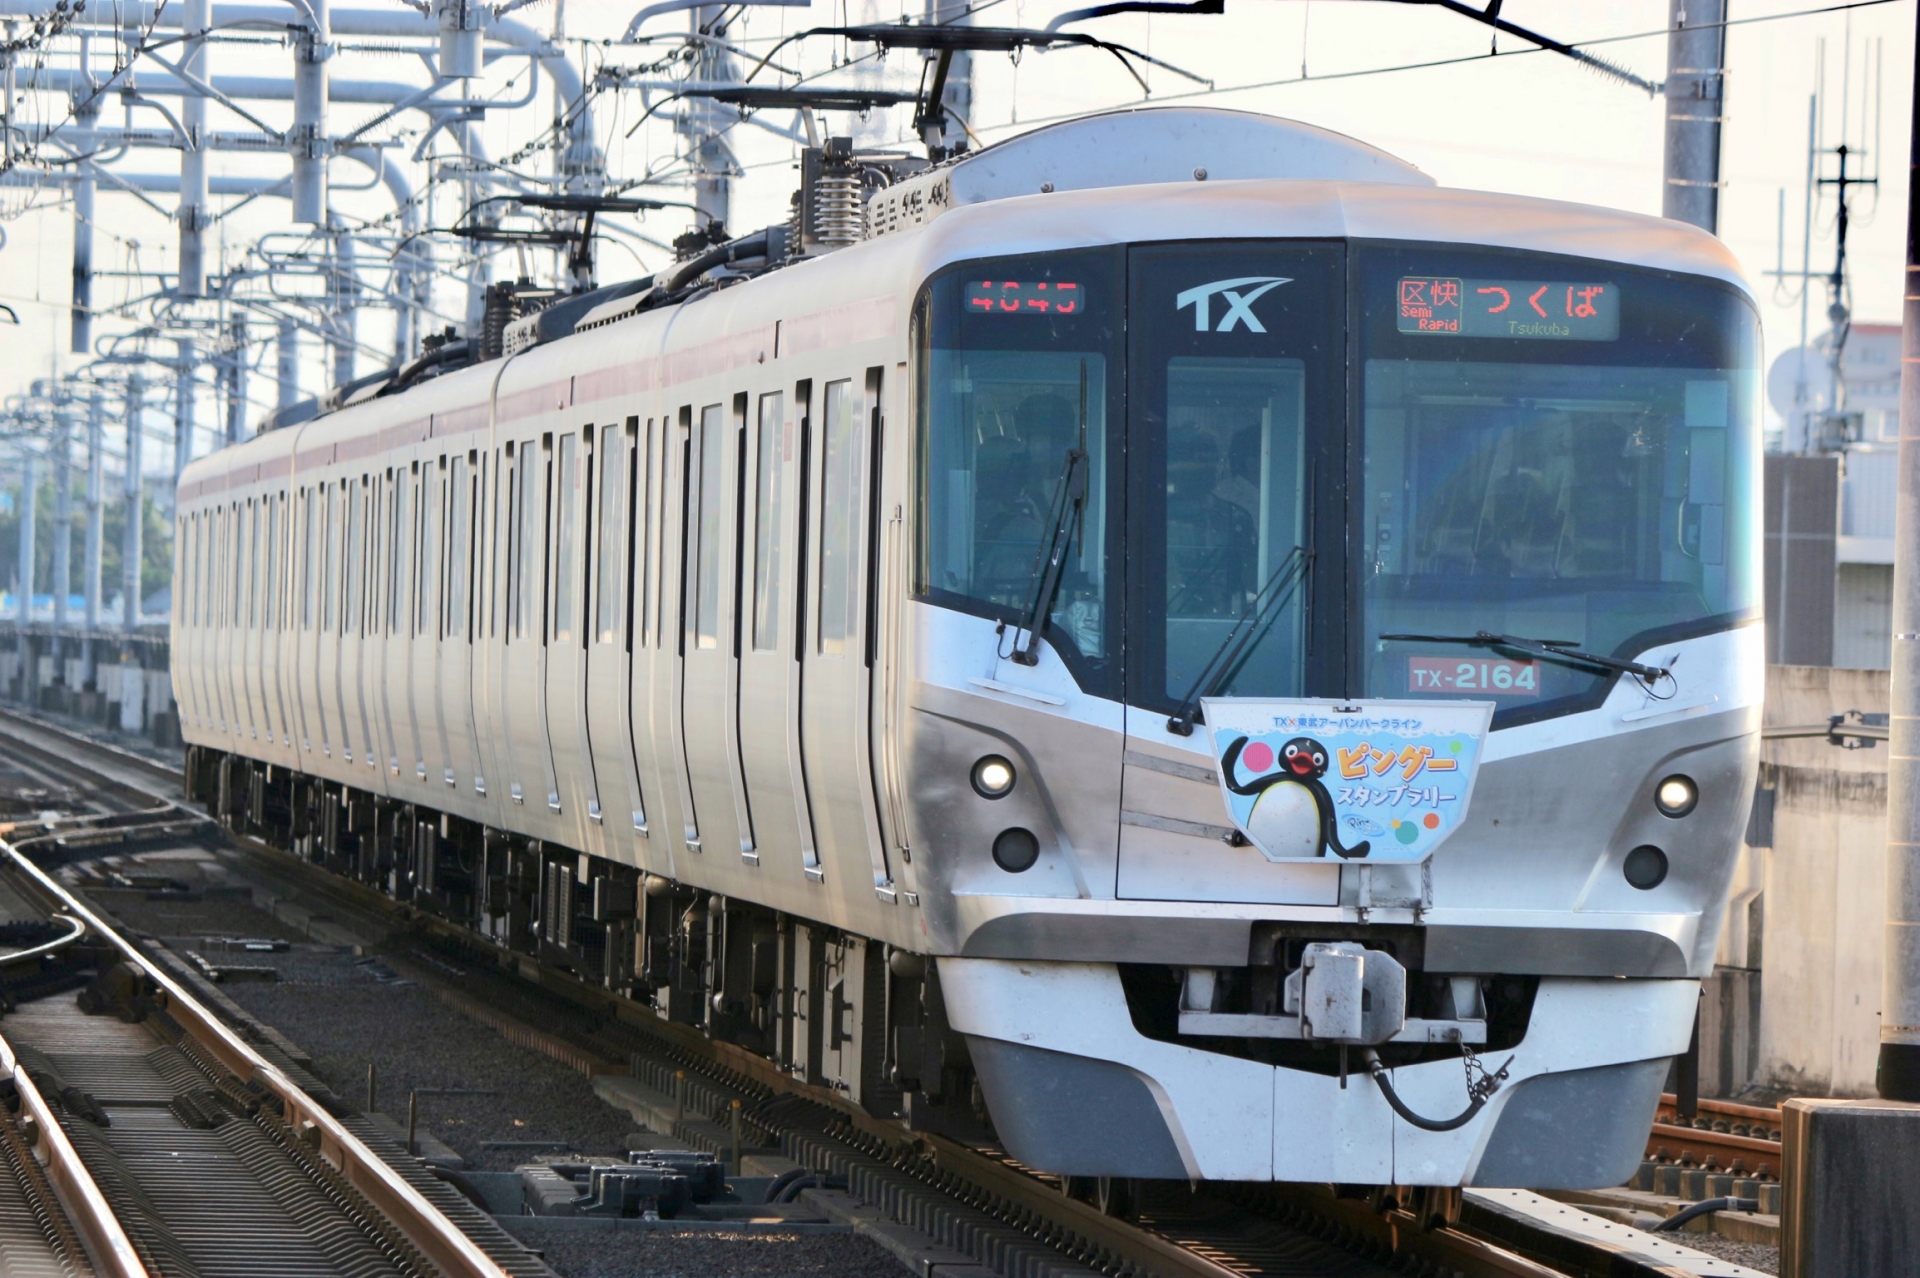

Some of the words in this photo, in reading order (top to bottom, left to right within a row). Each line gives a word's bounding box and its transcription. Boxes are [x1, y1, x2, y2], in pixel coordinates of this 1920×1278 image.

[1177, 276, 1295, 333] TX
[1401, 280, 1458, 306] 区快
[1477, 285, 1603, 318] つくば
[1401, 305, 1432, 318] Semi
[1509, 320, 1570, 336] Tsukuba
[1413, 663, 1536, 690] TX-2164
[1336, 742, 1457, 781] ピングー
[1337, 783, 1455, 807] スタンプラリー
